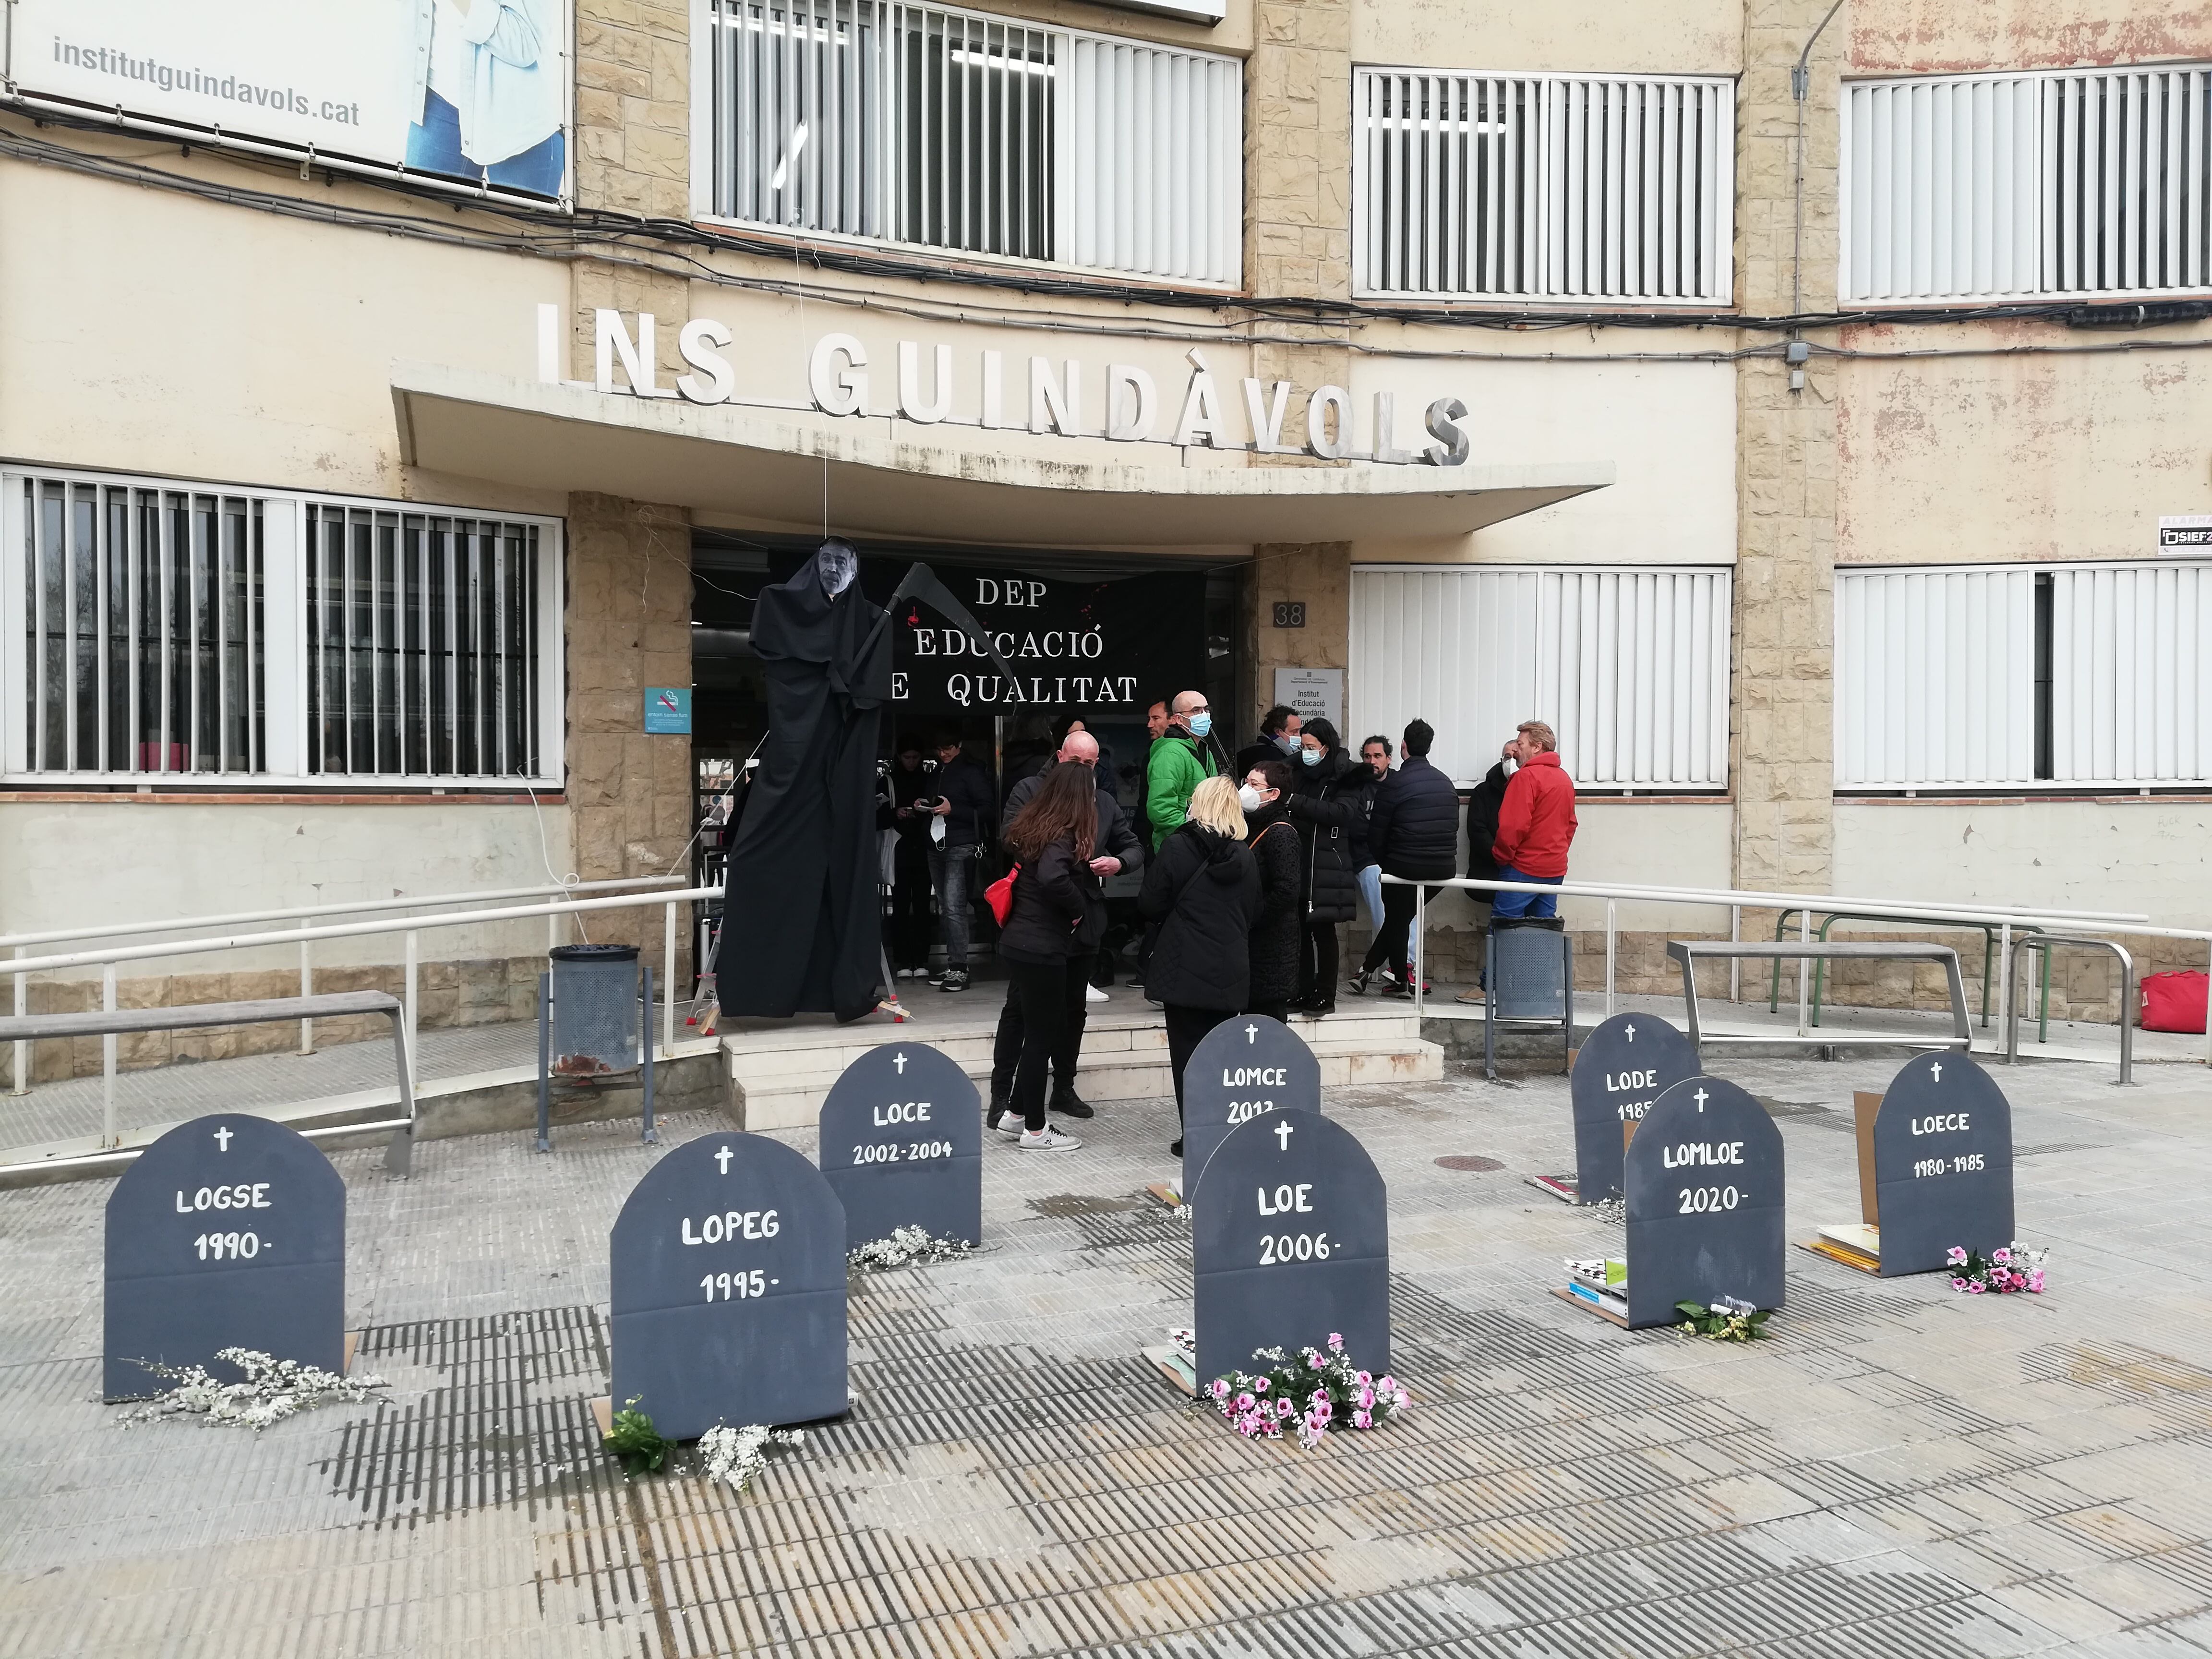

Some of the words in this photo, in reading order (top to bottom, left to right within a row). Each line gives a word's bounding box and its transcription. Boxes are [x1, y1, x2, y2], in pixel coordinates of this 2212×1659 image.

[54, 36, 360, 126] institutguindavols.cat
[536, 303, 734, 406] INS
[809, 332, 1470, 468] GUINDÀVOLS
[975, 577, 1047, 608] DEP
[1275, 604, 1301, 625] 38
[913, 624, 1103, 658] EDUCACIÓ
[892, 672, 909, 699] E
[947, 673, 1138, 707] QUALITAT
[1222, 1068, 1287, 1087] LOMCE
[1606, 1070, 1658, 1092] LODE
[873, 1102, 932, 1126] LOCE
[1911, 1113, 1970, 1135] LOECE
[853, 1141, 953, 1165] 2002-2004
[1663, 1142, 1745, 1169] LOMLOE
[1914, 1154, 1984, 1178] 1980-1985
[176, 1183, 272, 1213] LOGSE
[1258, 1183, 1313, 1216] LOE
[682, 1210, 780, 1245] LOPEG
